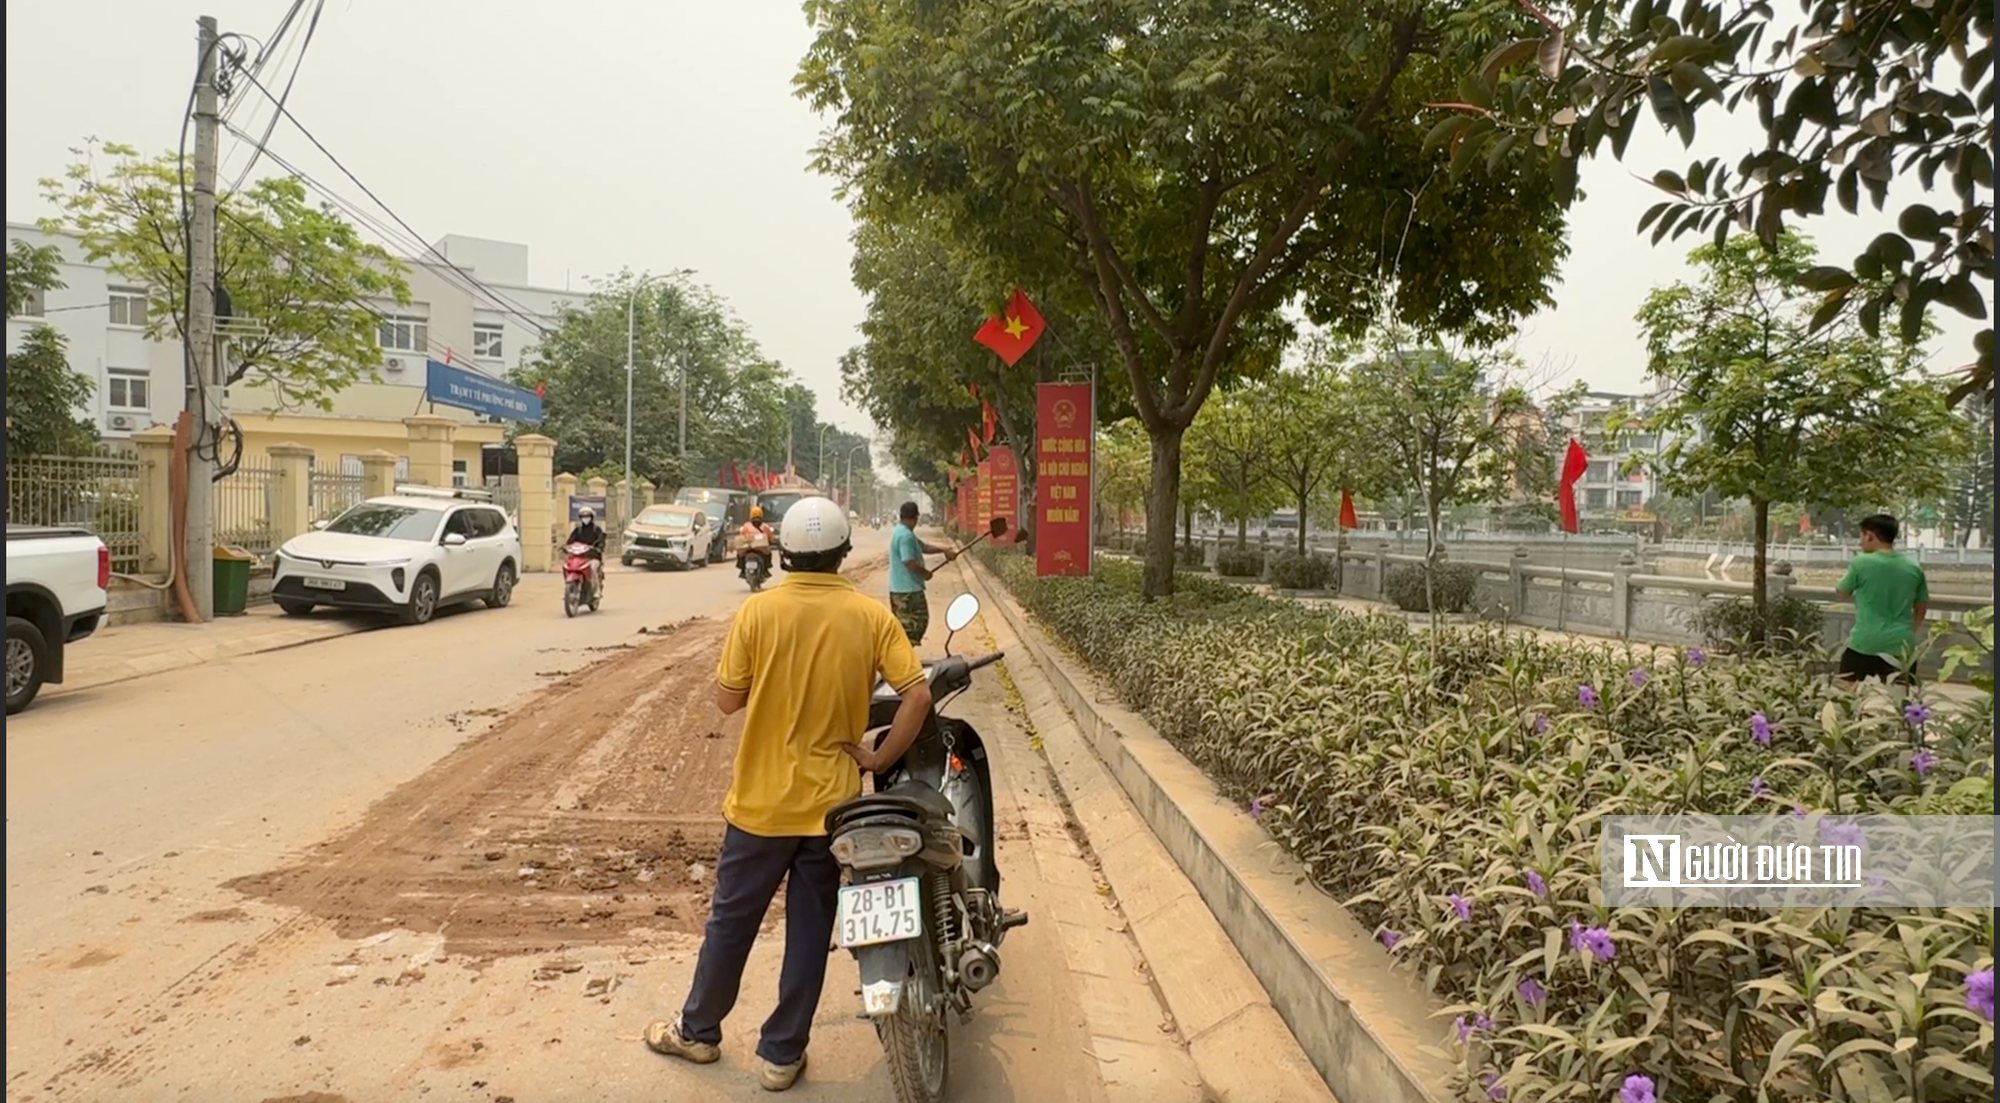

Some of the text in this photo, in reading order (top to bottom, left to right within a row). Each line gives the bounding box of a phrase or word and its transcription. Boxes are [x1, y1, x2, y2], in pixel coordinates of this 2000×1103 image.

[1050, 483, 1077, 502] VIỆT NAM
[851, 884, 906, 915] 28-B1
[845, 909, 915, 943] 314.75
